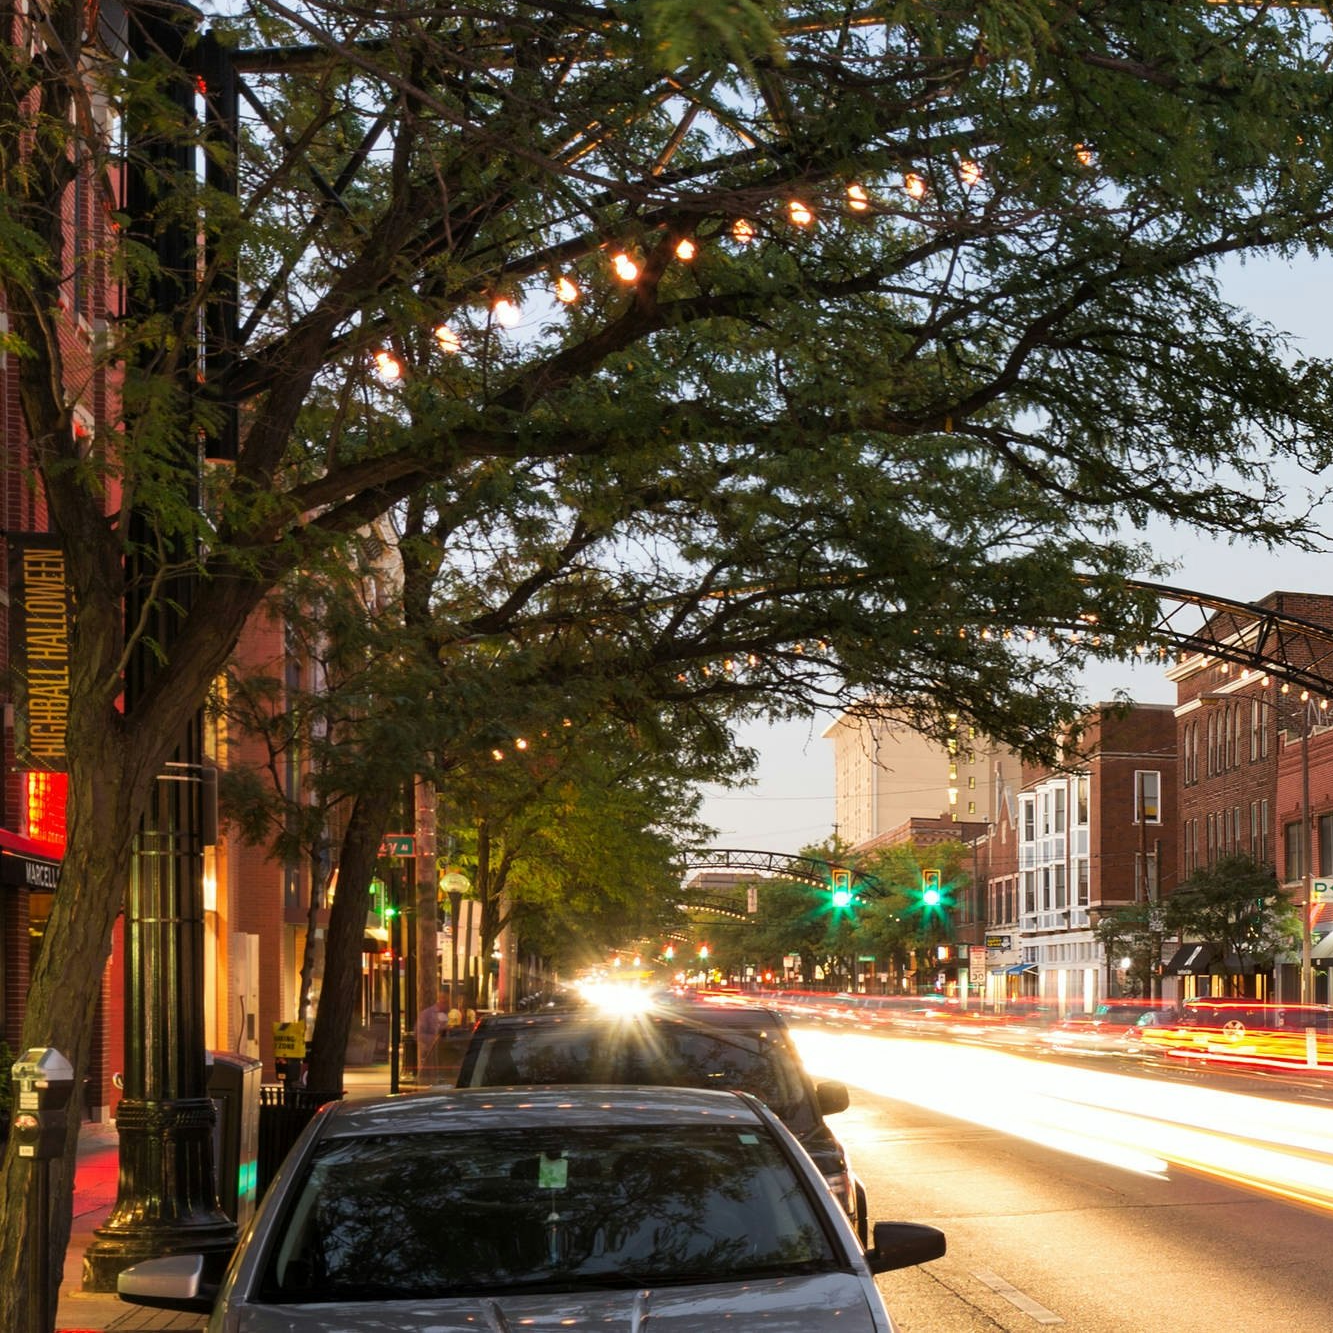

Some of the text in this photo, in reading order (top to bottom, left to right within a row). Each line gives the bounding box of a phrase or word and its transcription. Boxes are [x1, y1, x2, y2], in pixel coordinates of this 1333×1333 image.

[23, 549, 69, 660] HALLOWEEN
[28, 666, 70, 757] HIGHBALL
[25, 861, 60, 888] MARCELL
